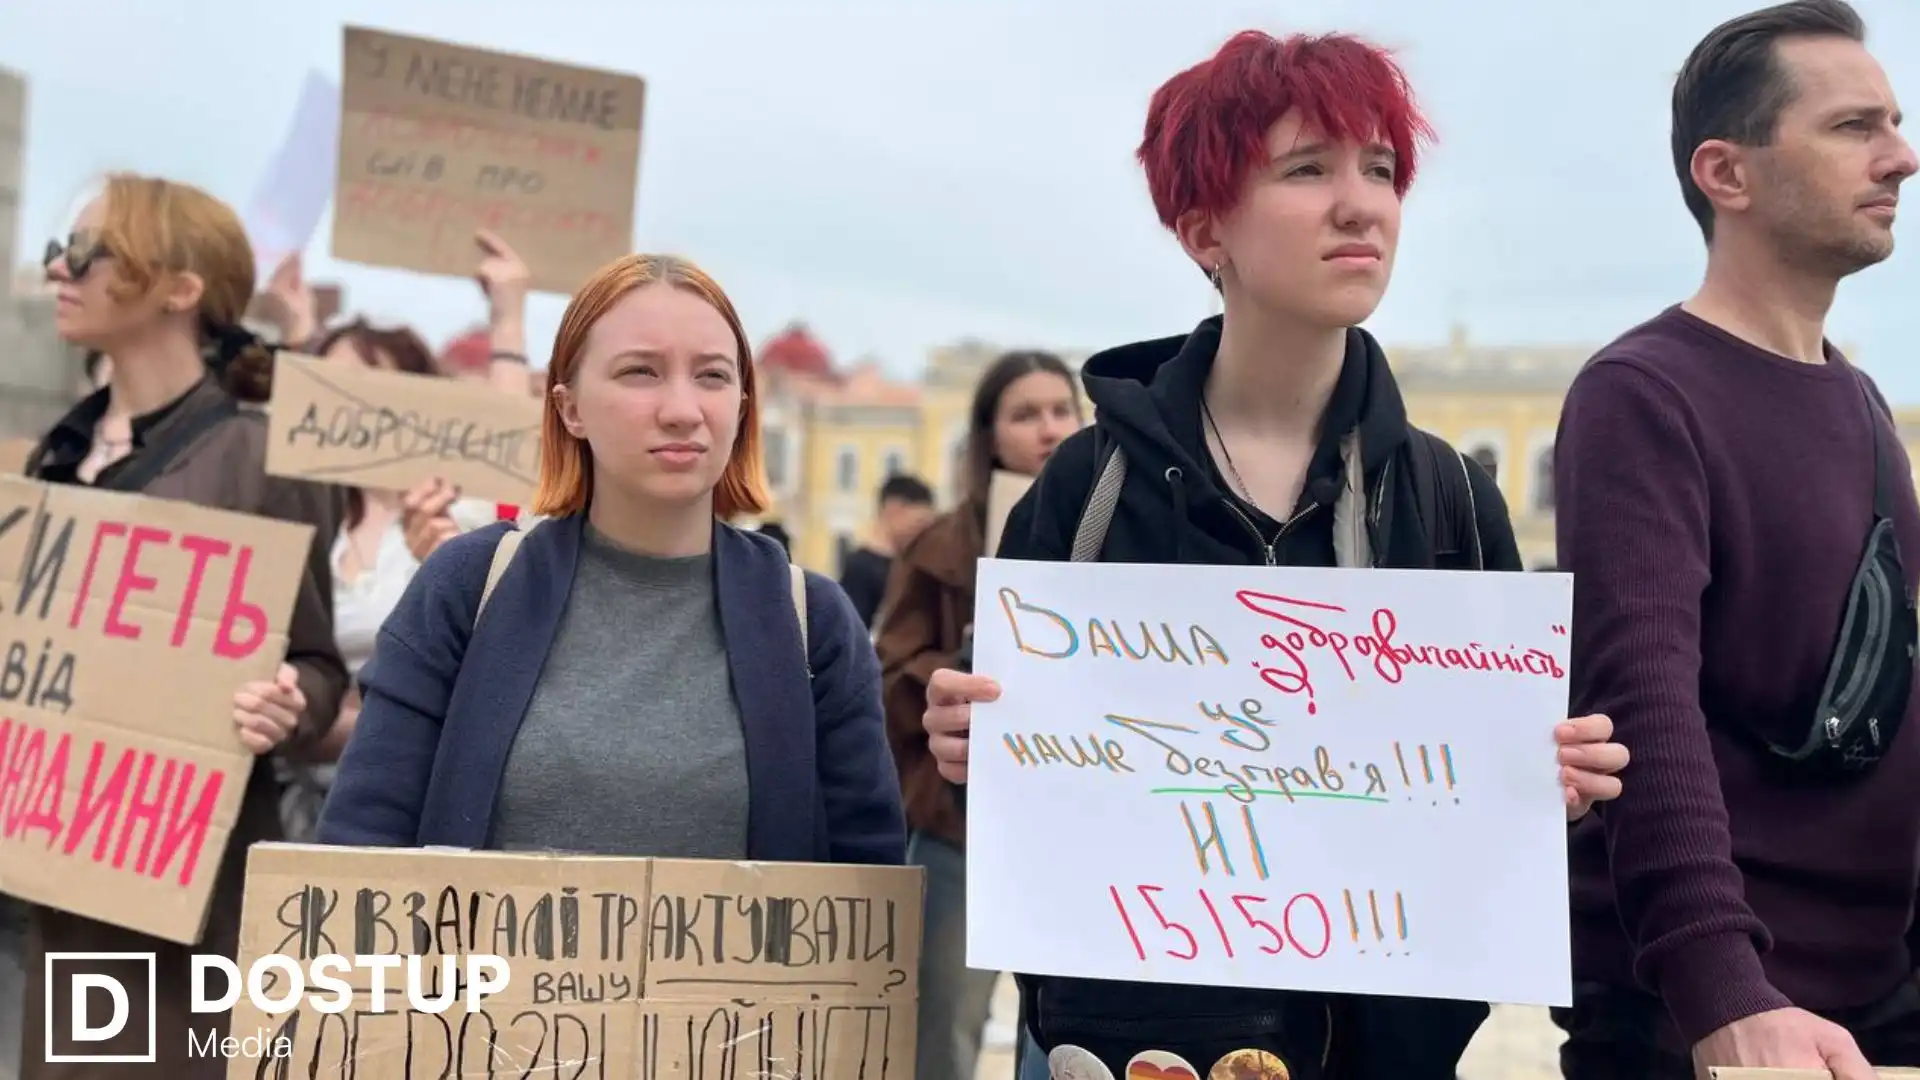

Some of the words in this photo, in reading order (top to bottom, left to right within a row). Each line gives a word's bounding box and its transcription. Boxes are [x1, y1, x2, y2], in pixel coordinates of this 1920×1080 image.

[68, 520, 269, 660] ГЕТЬ
[273, 884, 339, 960] ЯК
[533, 970, 632, 1004] ВАШУ
